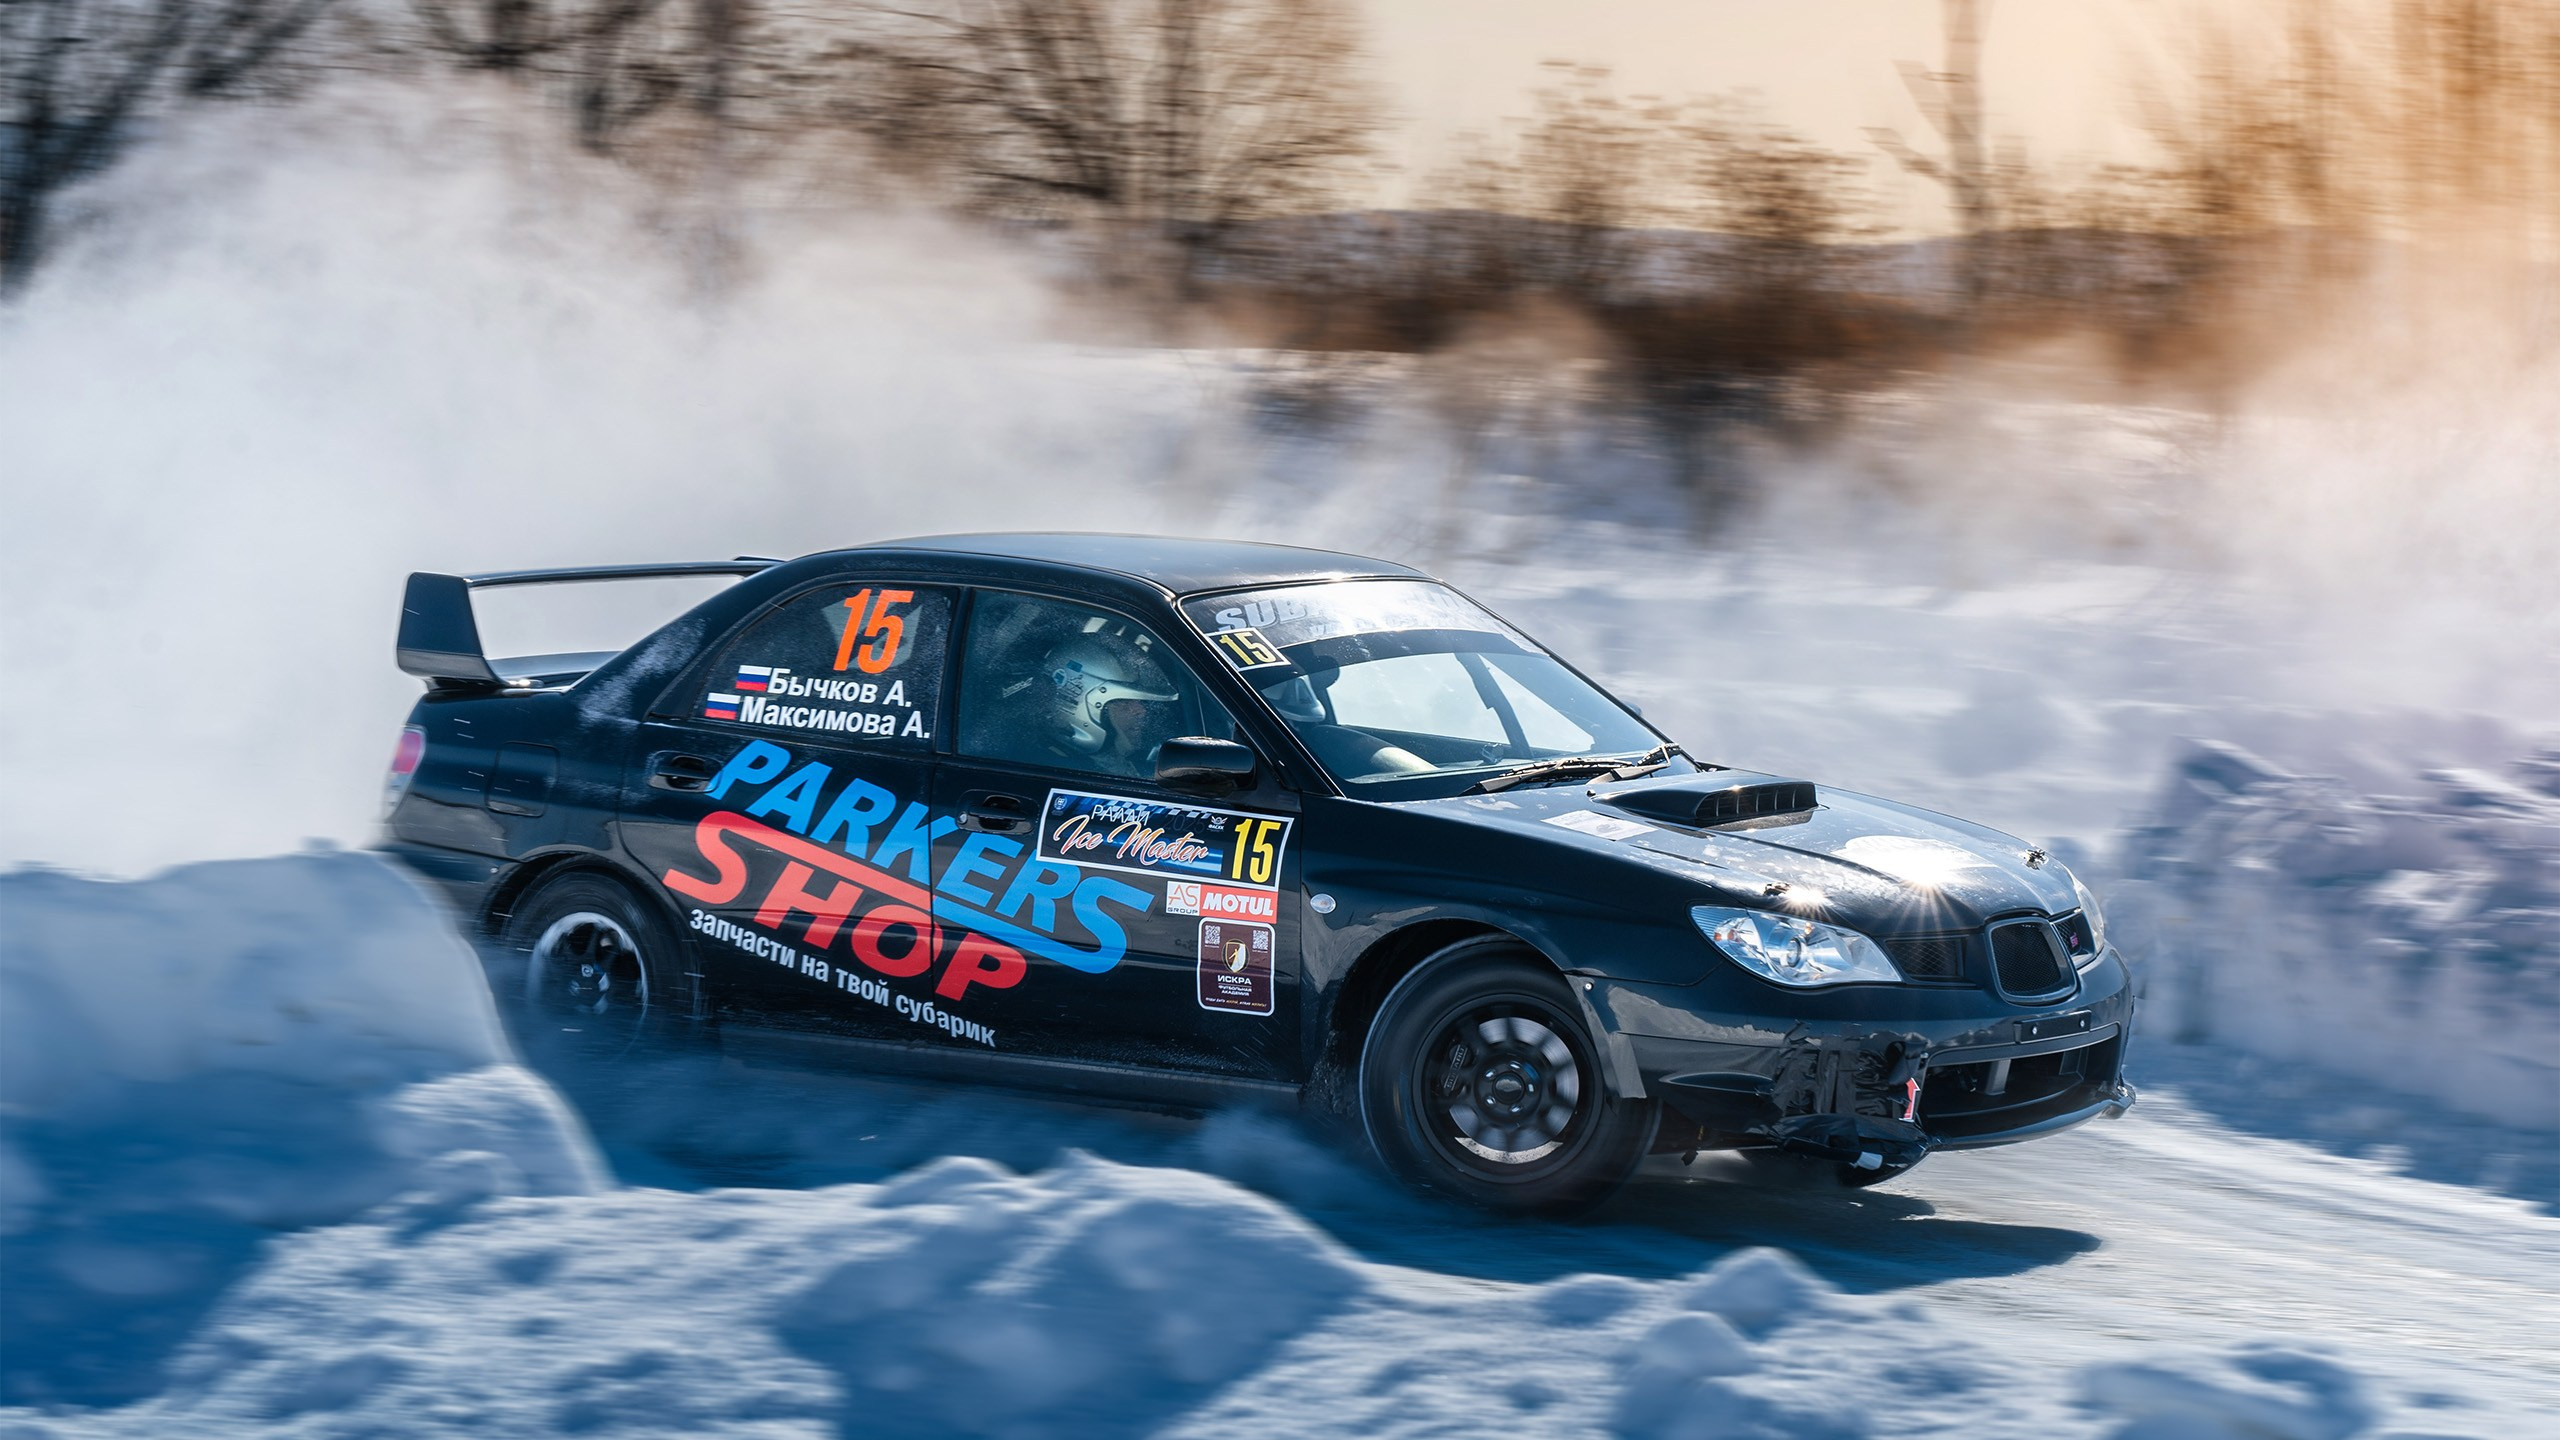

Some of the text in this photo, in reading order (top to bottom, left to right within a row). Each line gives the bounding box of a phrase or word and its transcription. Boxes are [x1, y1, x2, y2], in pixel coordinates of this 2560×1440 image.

[833, 588, 915, 674] 15
[1219, 631, 1276, 665] 15
[767, 667, 912, 707] Бычков А.
[739, 695, 930, 739] Максимова А.
[706, 739, 1155, 975] PARKERS
[1053, 814, 1209, 866] Ice Master
[1232, 818, 1281, 883] 15
[662, 810, 1027, 1001] SHOP
[1167, 907, 1199, 915] GROUP
[1202, 892, 1274, 916] MOTUL
[690, 908, 996, 1048] запчасти на твой субарик
[1217, 974, 1252, 985] ИСКРА
